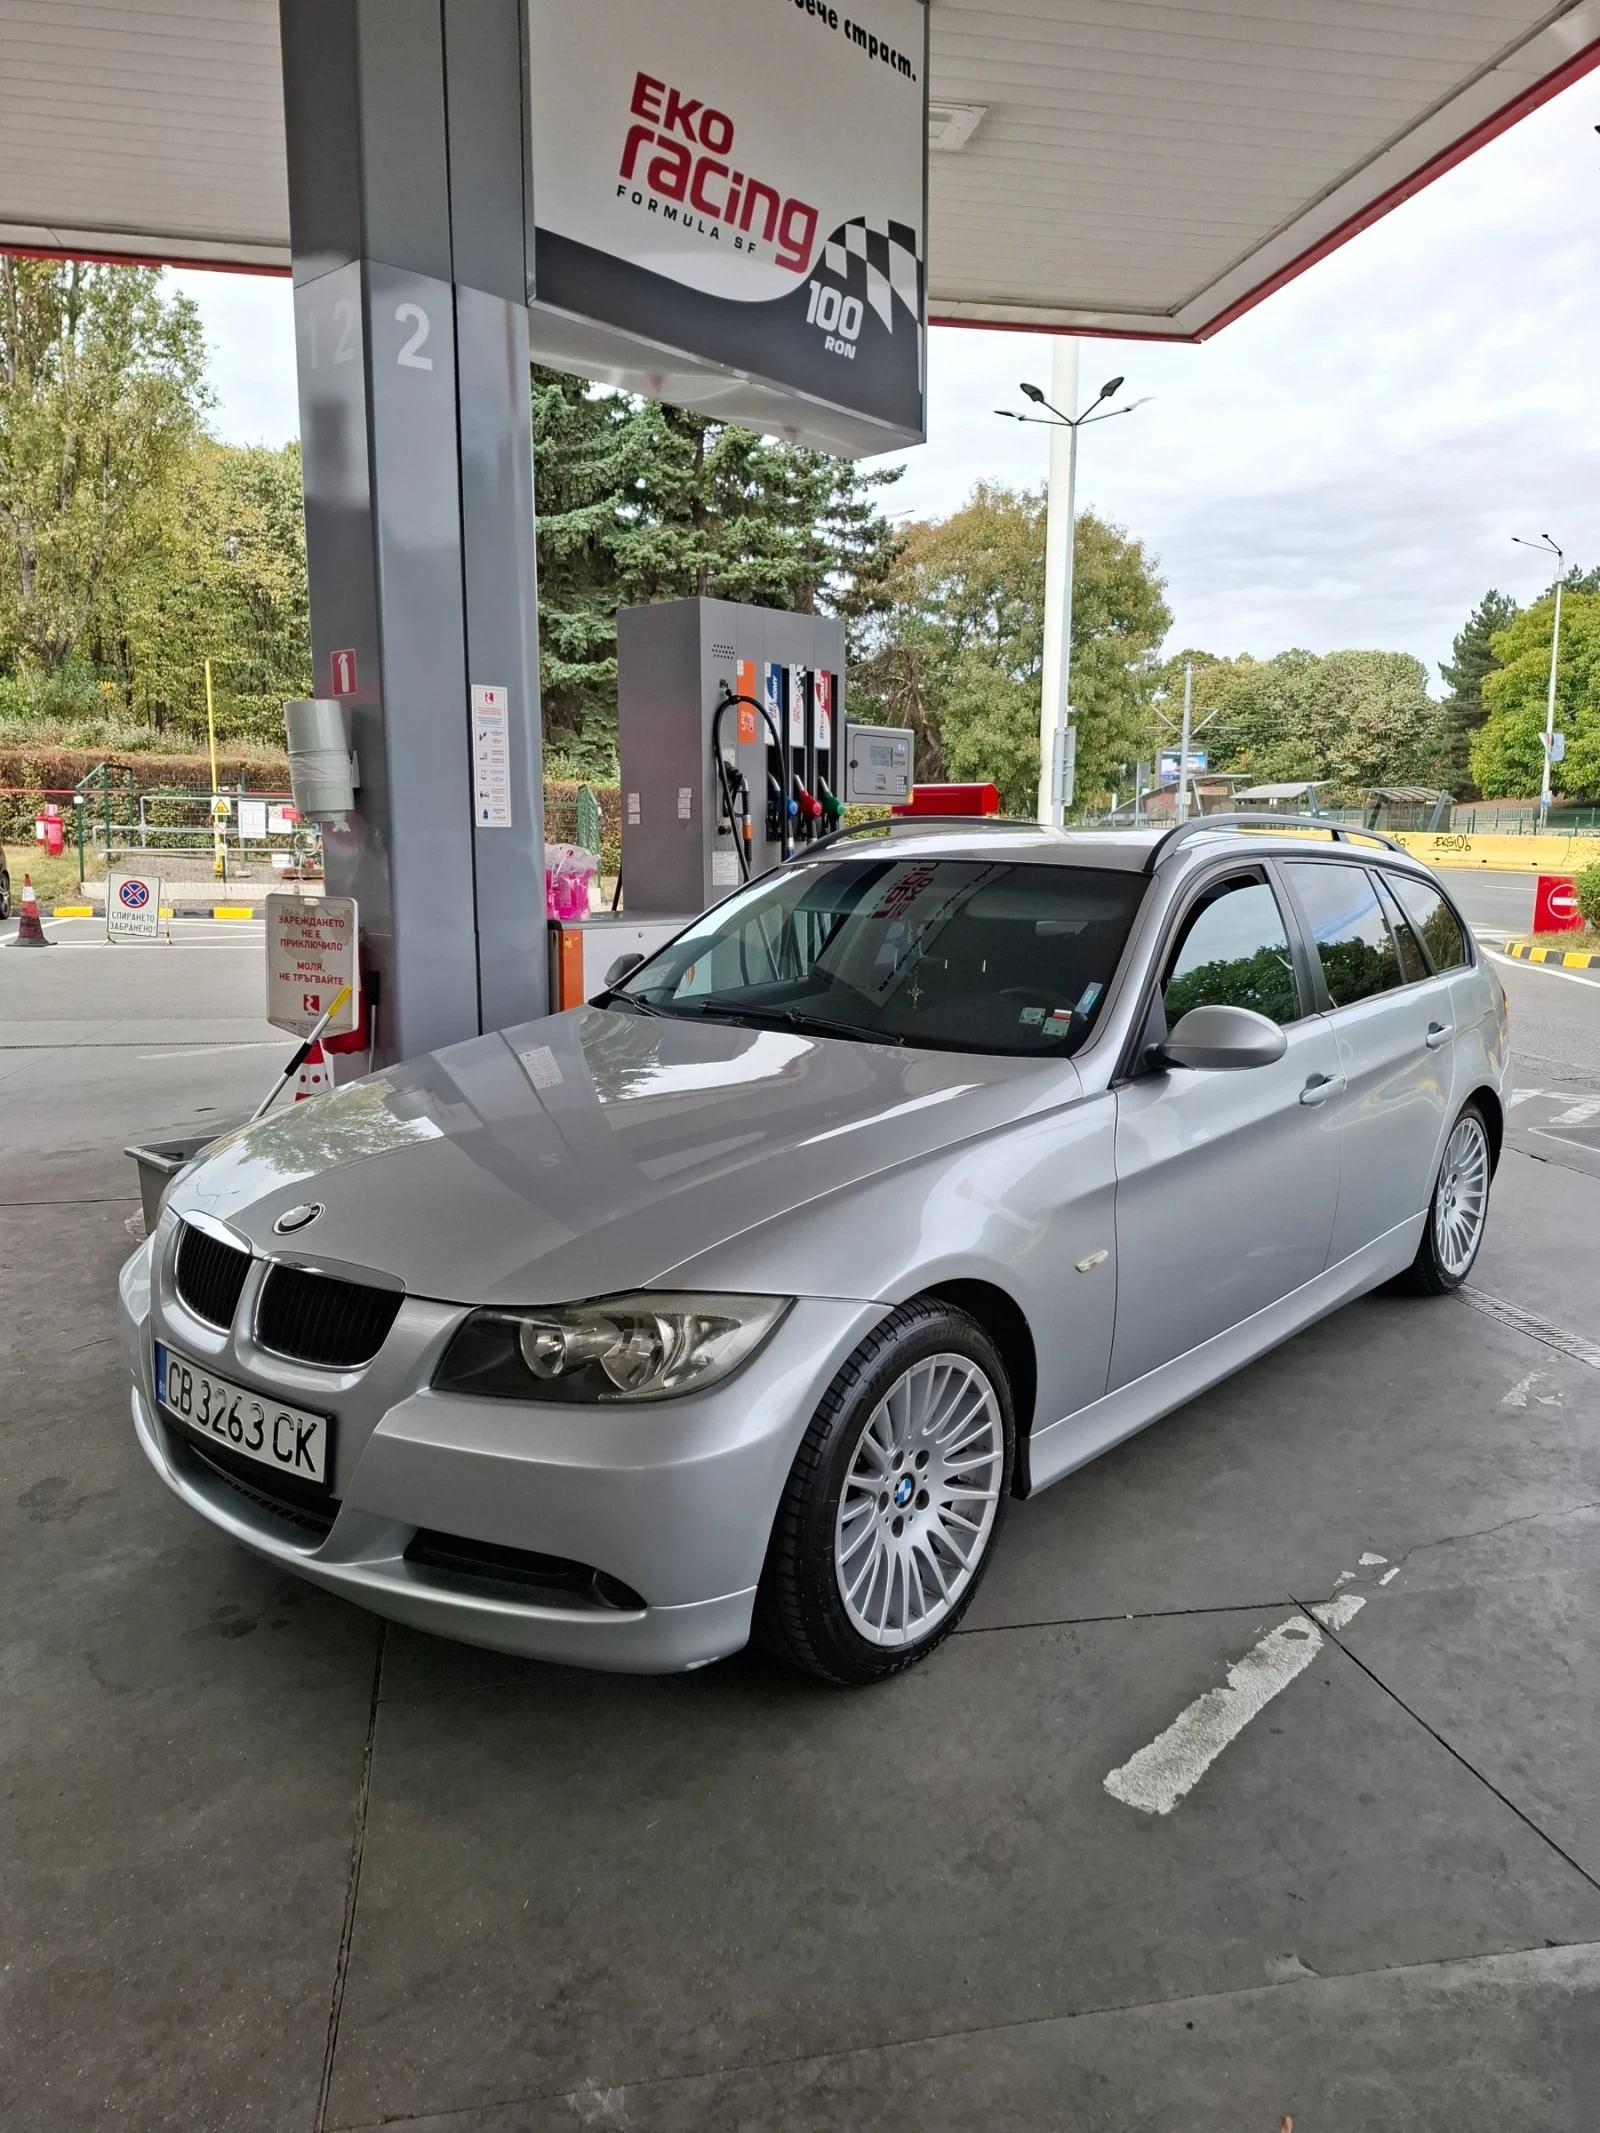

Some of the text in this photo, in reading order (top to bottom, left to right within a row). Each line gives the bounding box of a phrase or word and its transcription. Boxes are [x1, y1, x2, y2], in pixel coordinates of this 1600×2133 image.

[630, 70, 735, 156] EKO
[618, 124, 819, 275] racing
[616, 185, 757, 255] FORMULA SF
[806, 279, 864, 341] 100
[394, 302, 433, 372] 2
[825, 335, 857, 360] RON
[111, 911, 155, 923] СПИРАНЕТО
[278, 915, 345, 929] ЗАРЕЖДАНЕТО
[109, 921, 156, 934] ЗАБРАНЕНО!
[301, 929, 321, 939] НЕ Е
[280, 939, 343, 952] ПРИКЛЮЧИЛО
[297, 961, 326, 973] МОЛЯ,
[279, 973, 344, 986] НЕ ТРЪГВАЙТЕ
[168, 1361, 318, 1473] CB 3263 CK
